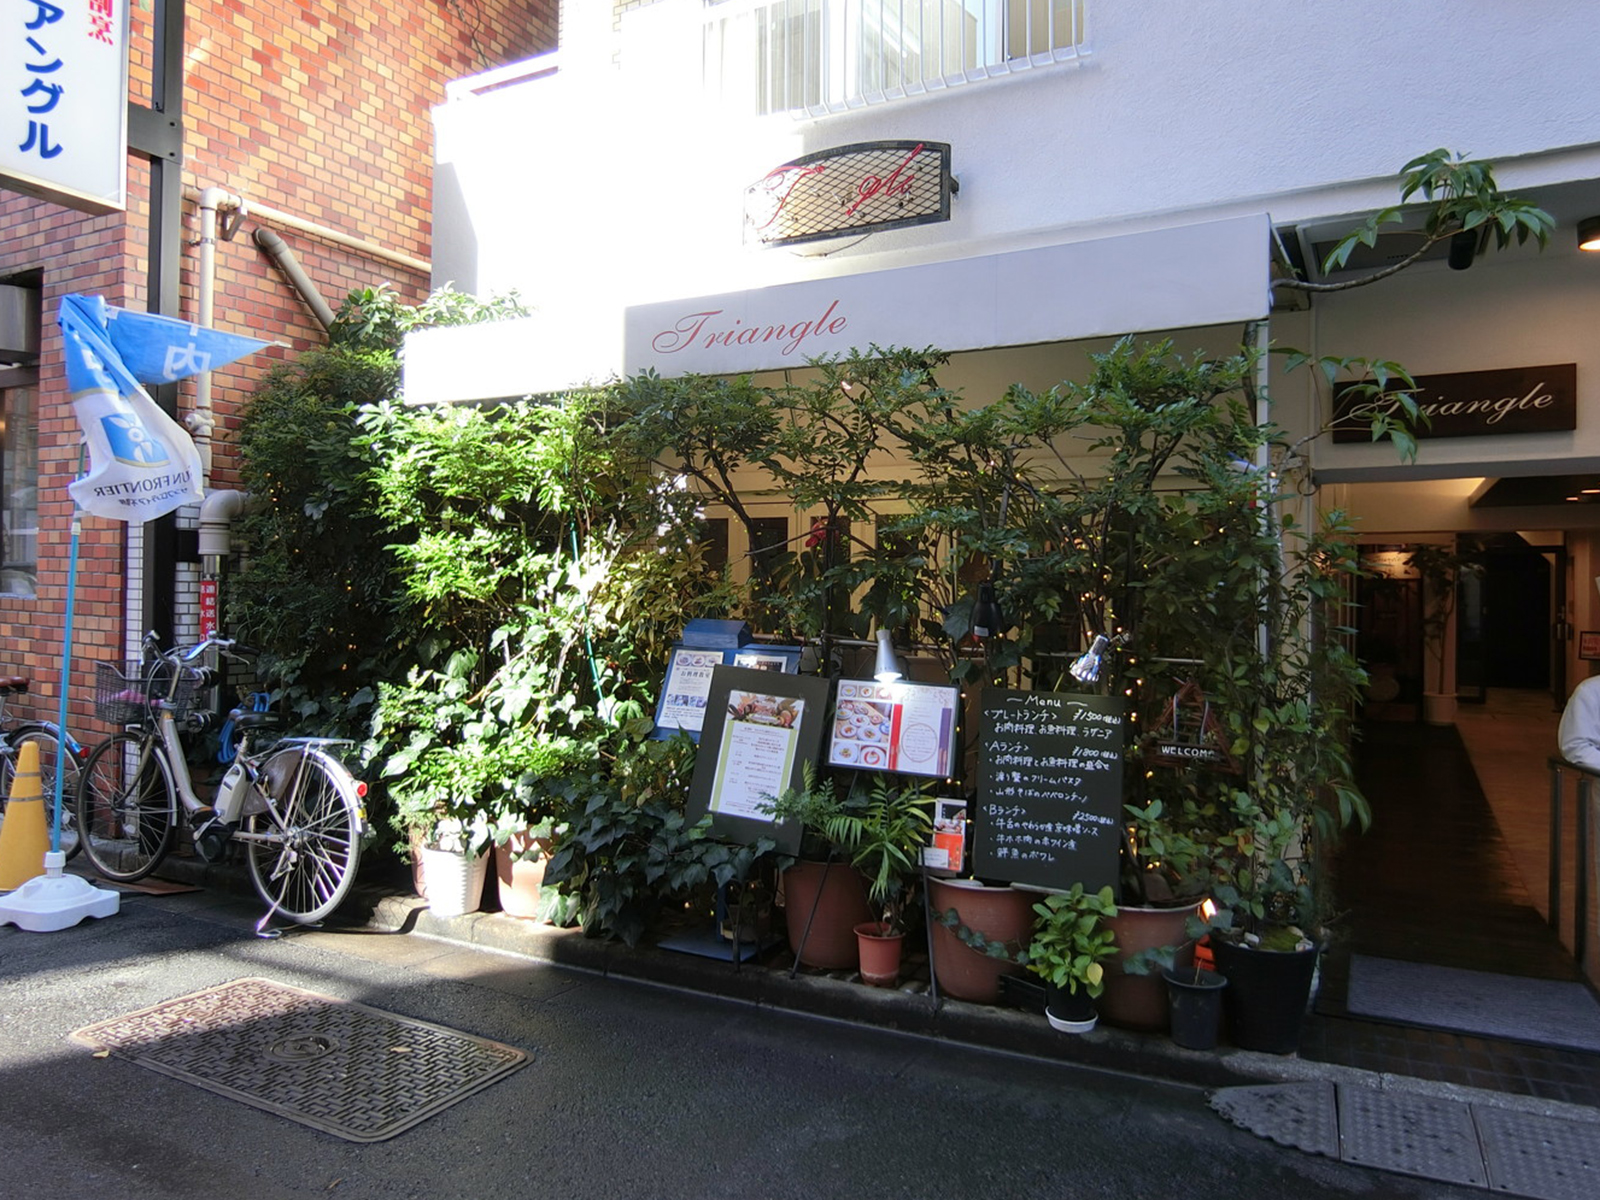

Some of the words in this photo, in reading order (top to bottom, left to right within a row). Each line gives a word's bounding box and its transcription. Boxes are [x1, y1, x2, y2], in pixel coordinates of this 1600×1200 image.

[651, 299, 848, 357] Triangle
[1349, 382, 1554, 425] Tiangle
[1024, 694, 1062, 708] Menu
